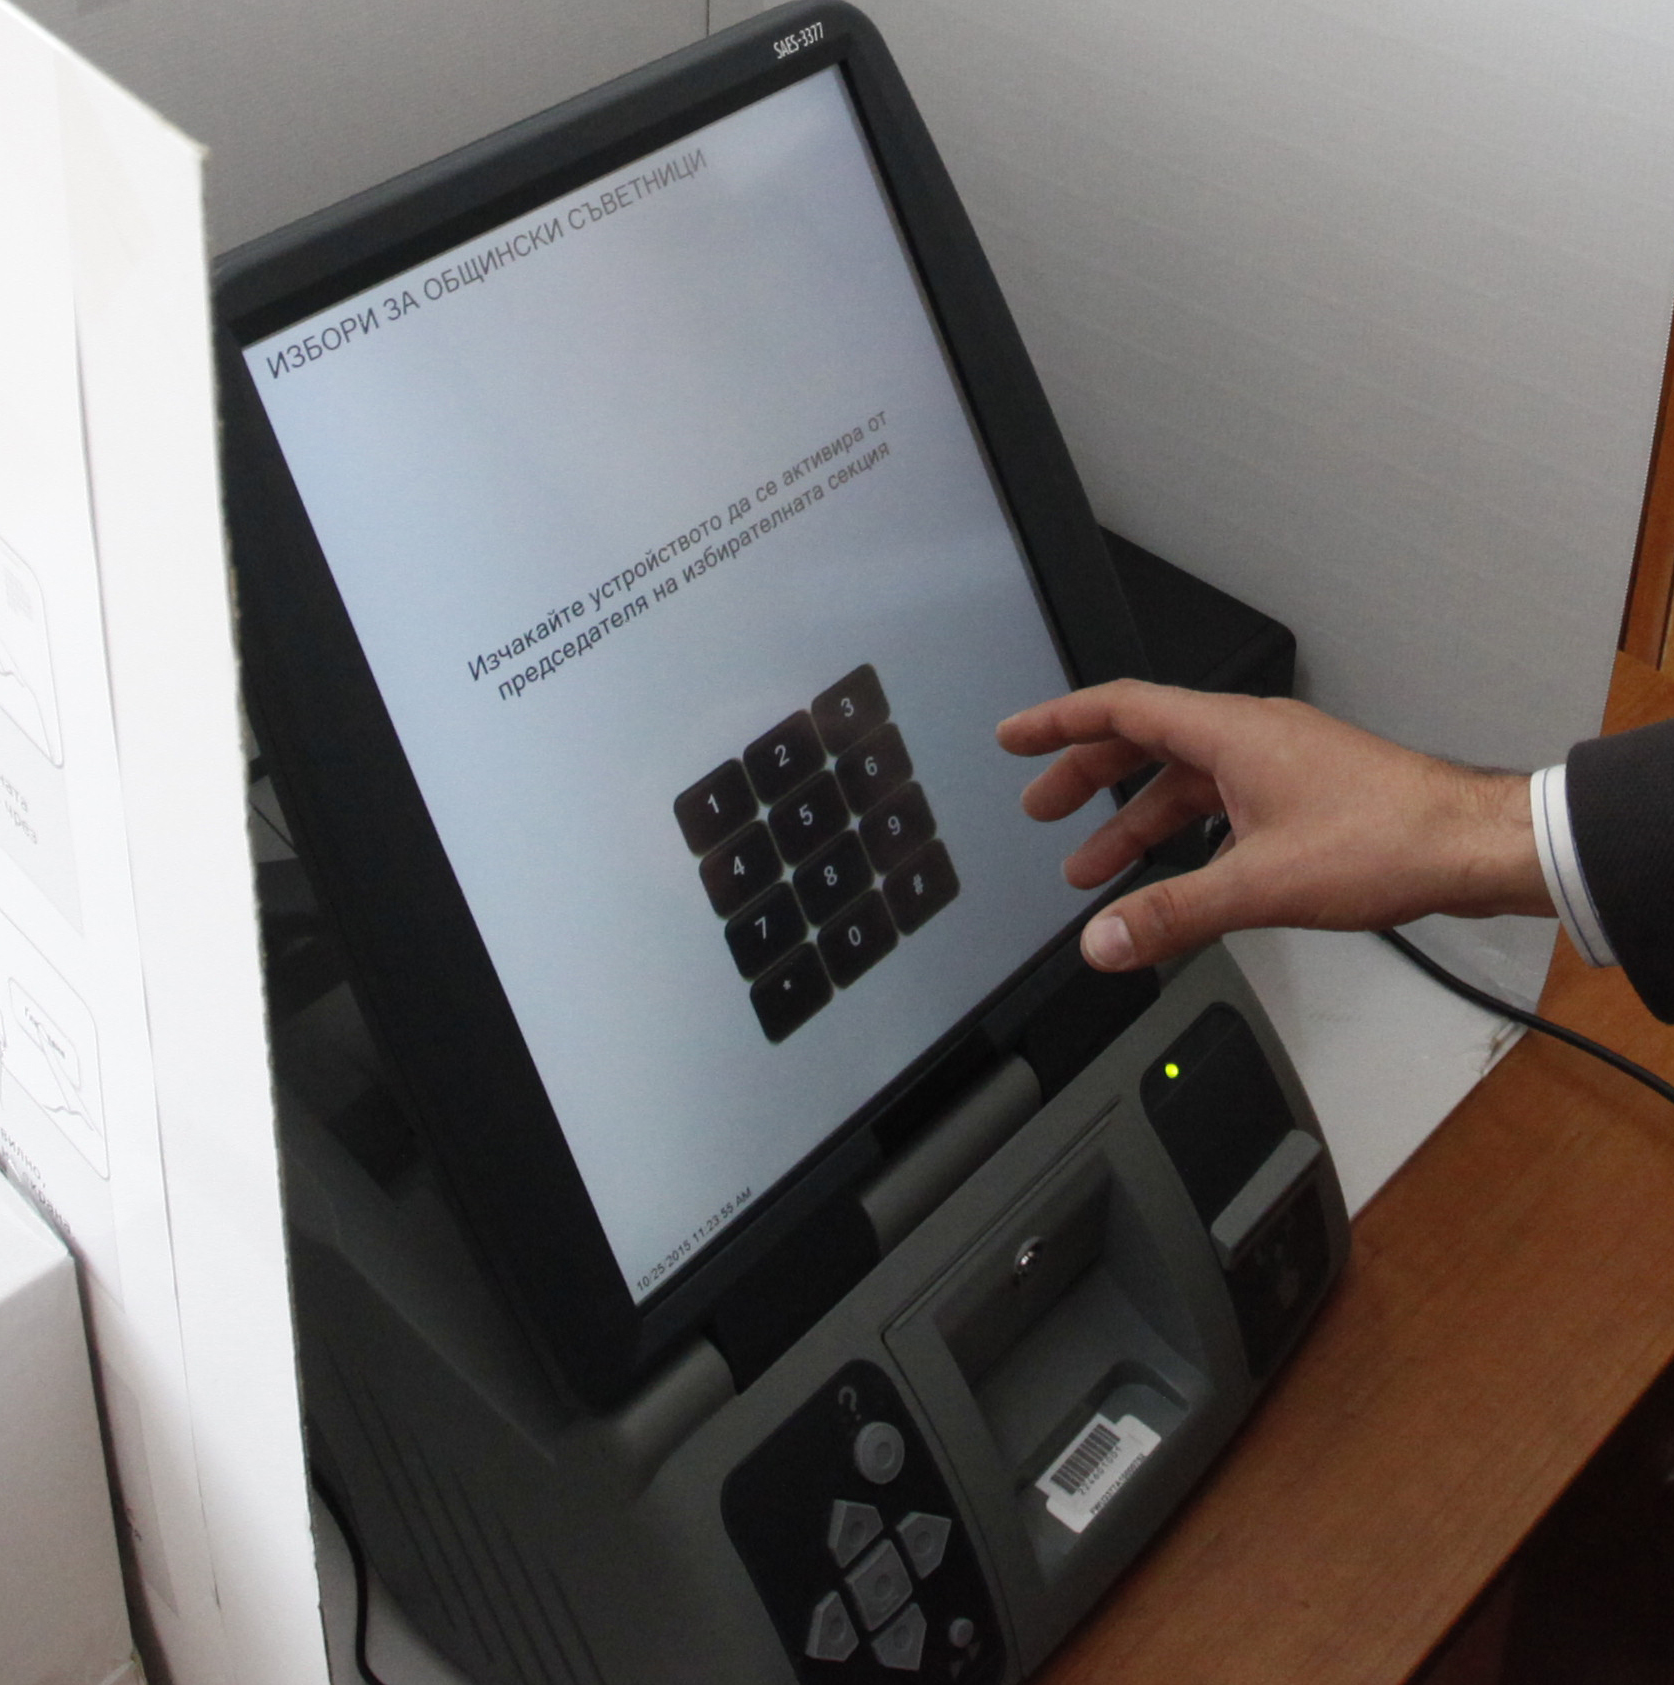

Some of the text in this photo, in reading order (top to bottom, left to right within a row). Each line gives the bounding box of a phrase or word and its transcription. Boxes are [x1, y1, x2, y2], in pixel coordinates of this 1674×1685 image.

[773, 21, 825, 61] SAES-3377
[267, 148, 708, 379] ИЗБОРИ ЗА ОБЩИНСКИ СЪВЕТНИЦИ
[467, 411, 887, 682] Изчакайте устройството да се активира от
[497, 442, 891, 701] председателя на избирателната секция
[840, 697, 854, 717] 3
[774, 744, 790, 767] 2
[864, 756, 878, 776] 6
[707, 793, 719, 813] 1
[799, 804, 814, 826] 5
[887, 816, 902, 836] 9
[733, 856, 745, 876] 4
[823, 865, 838, 886] 8
[754, 917, 767, 939] 7
[848, 926, 862, 946] 0
